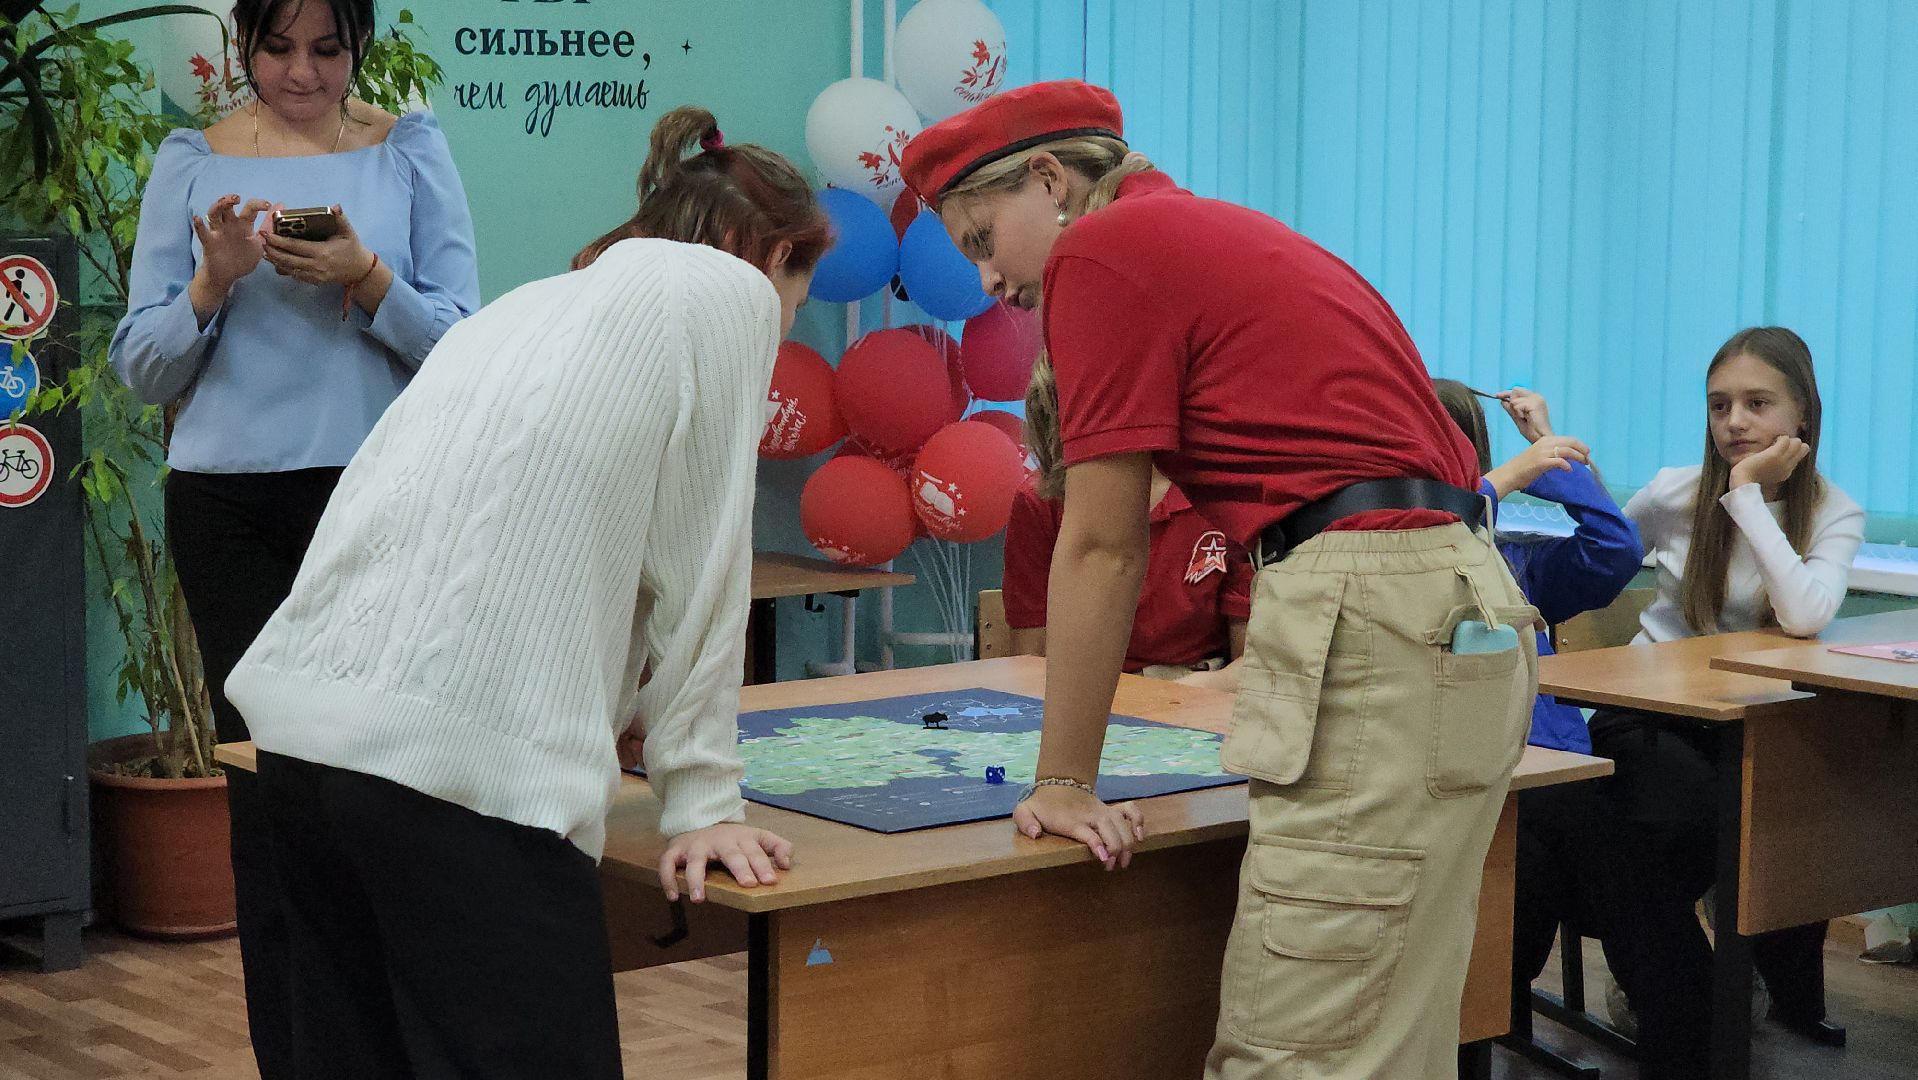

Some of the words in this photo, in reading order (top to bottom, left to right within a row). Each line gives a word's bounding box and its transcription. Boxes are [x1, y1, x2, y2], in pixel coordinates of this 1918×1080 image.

[454, 27, 651, 70] сильнее,
[453, 79, 508, 111] чем
[524, 78, 650, 137] думаешь
